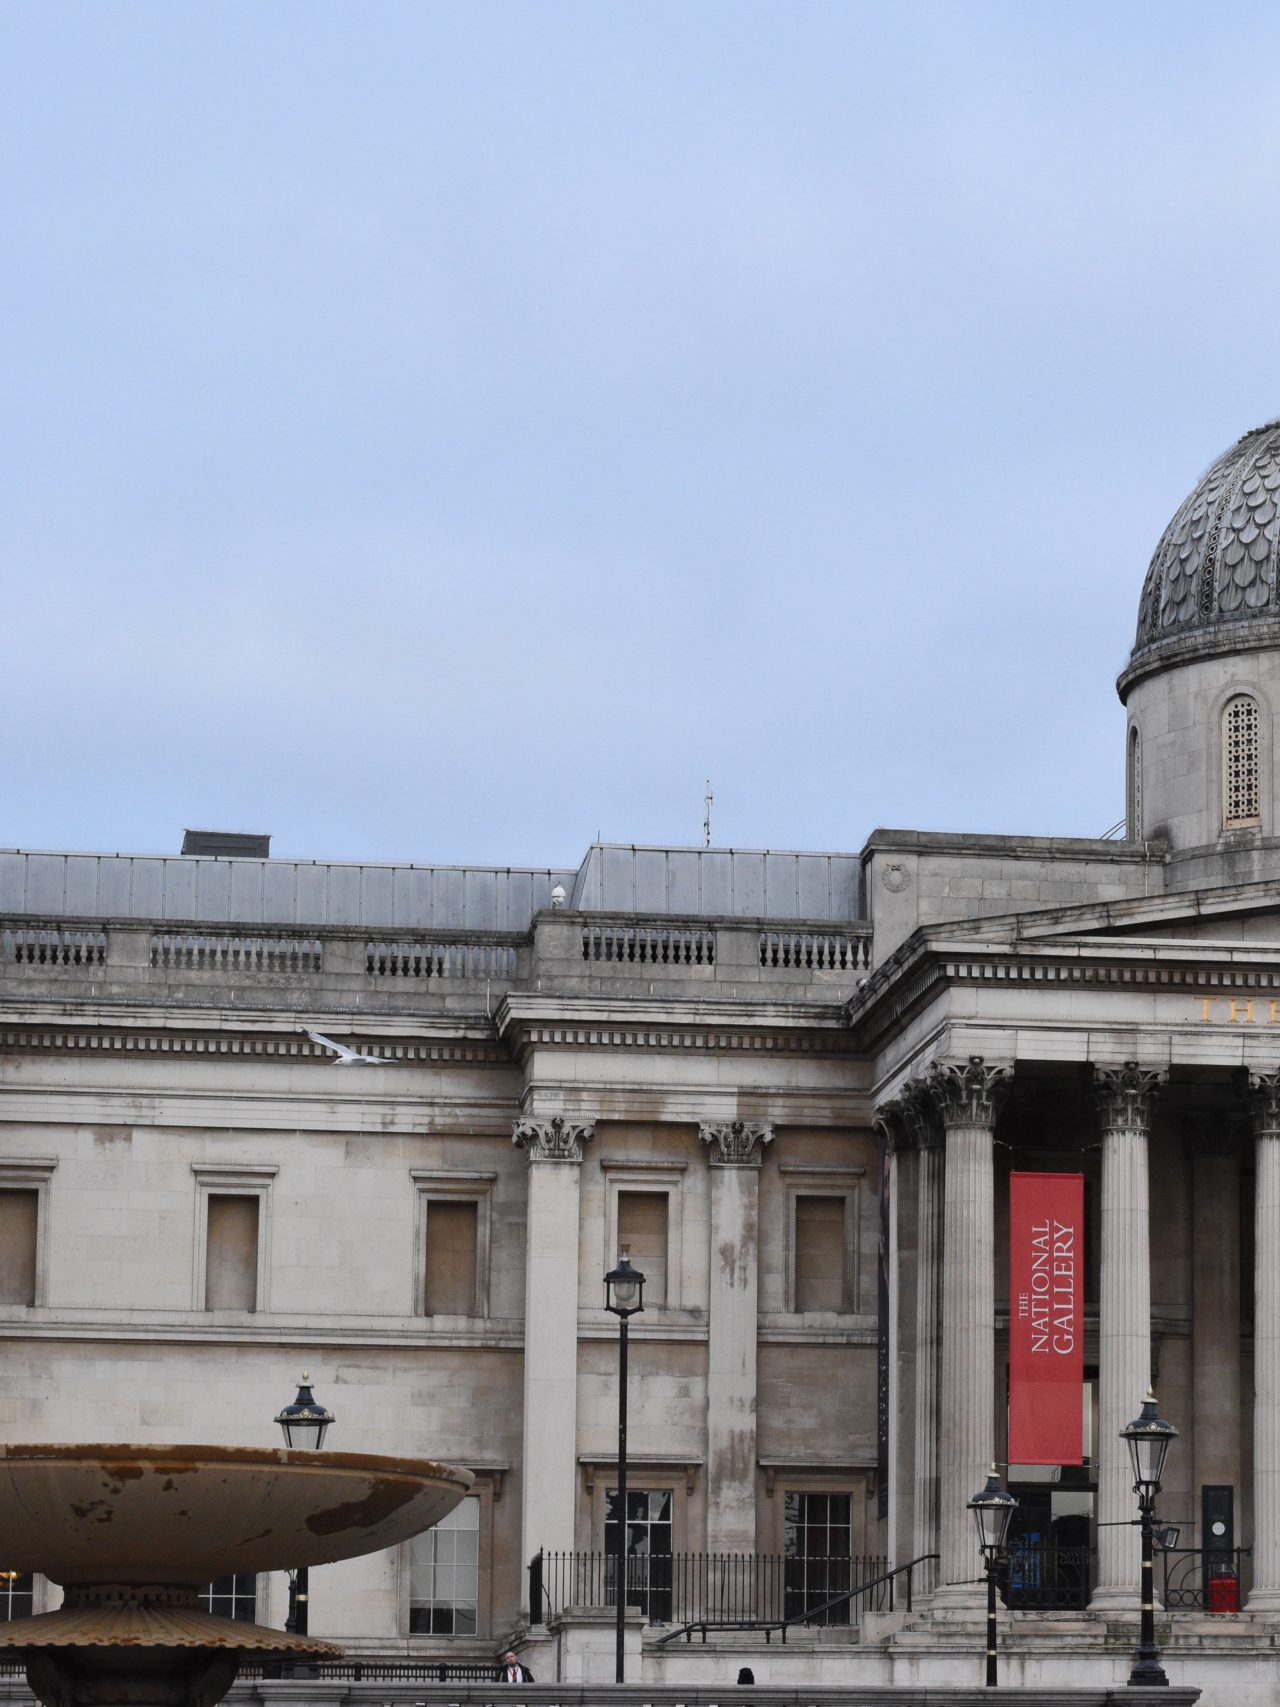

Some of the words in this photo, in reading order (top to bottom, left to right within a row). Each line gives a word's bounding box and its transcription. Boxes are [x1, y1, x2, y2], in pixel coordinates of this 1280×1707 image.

[1019, 1292, 1029, 1319] THE
[1031, 1219, 1050, 1354] NATIONAL
[1053, 1220, 1074, 1354] GALLERY
